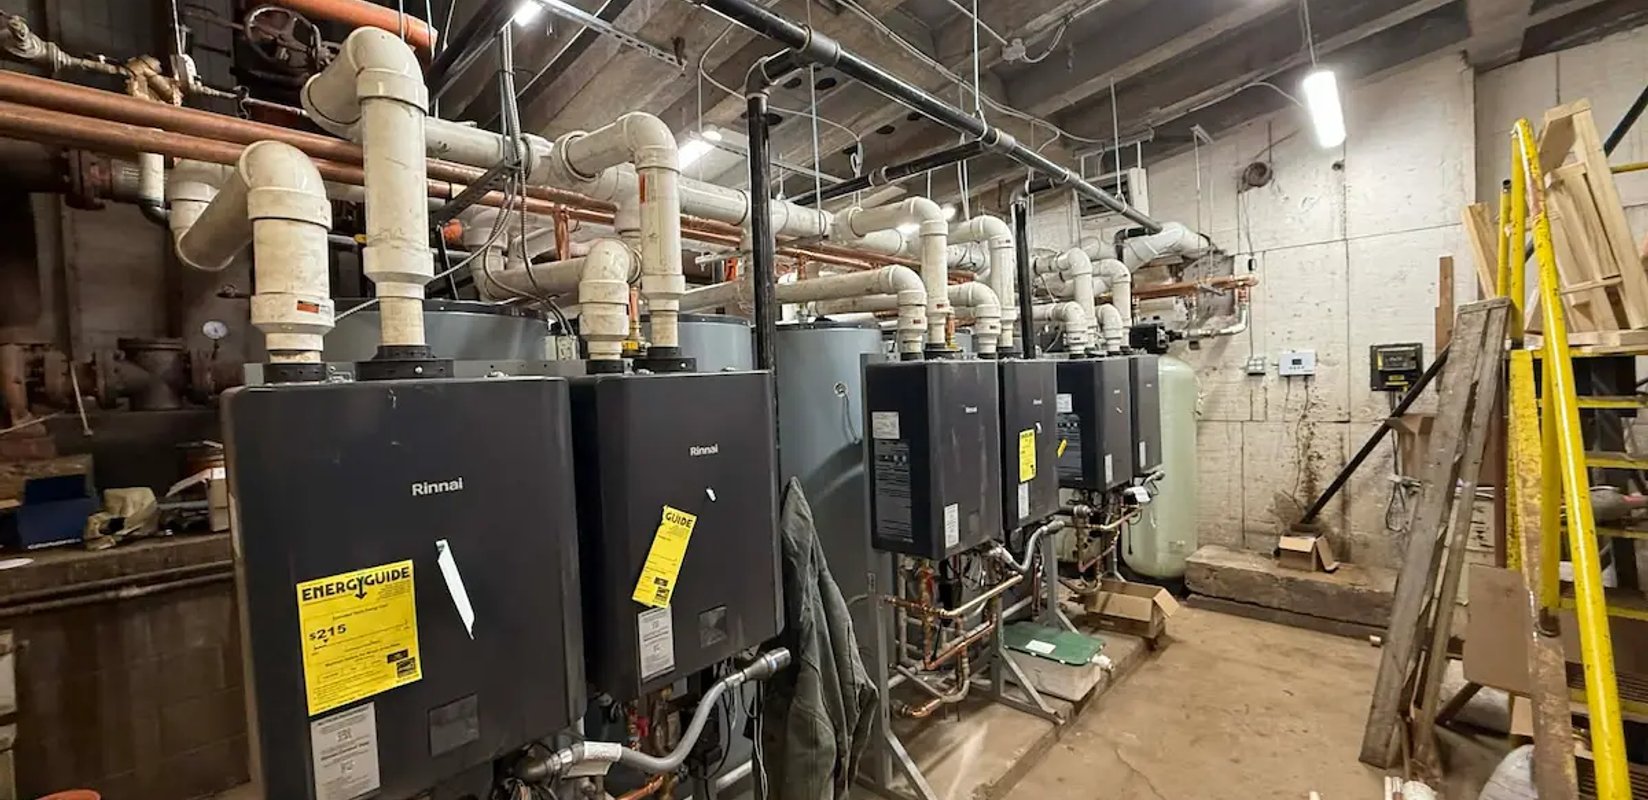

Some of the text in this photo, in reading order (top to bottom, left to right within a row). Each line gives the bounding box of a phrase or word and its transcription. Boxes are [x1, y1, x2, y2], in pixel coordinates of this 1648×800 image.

[690, 443, 718, 456] Rinnai
[412, 477, 463, 496] Rinnai
[665, 512, 693, 528] GUIDE
[309, 624, 347, 641] $215
